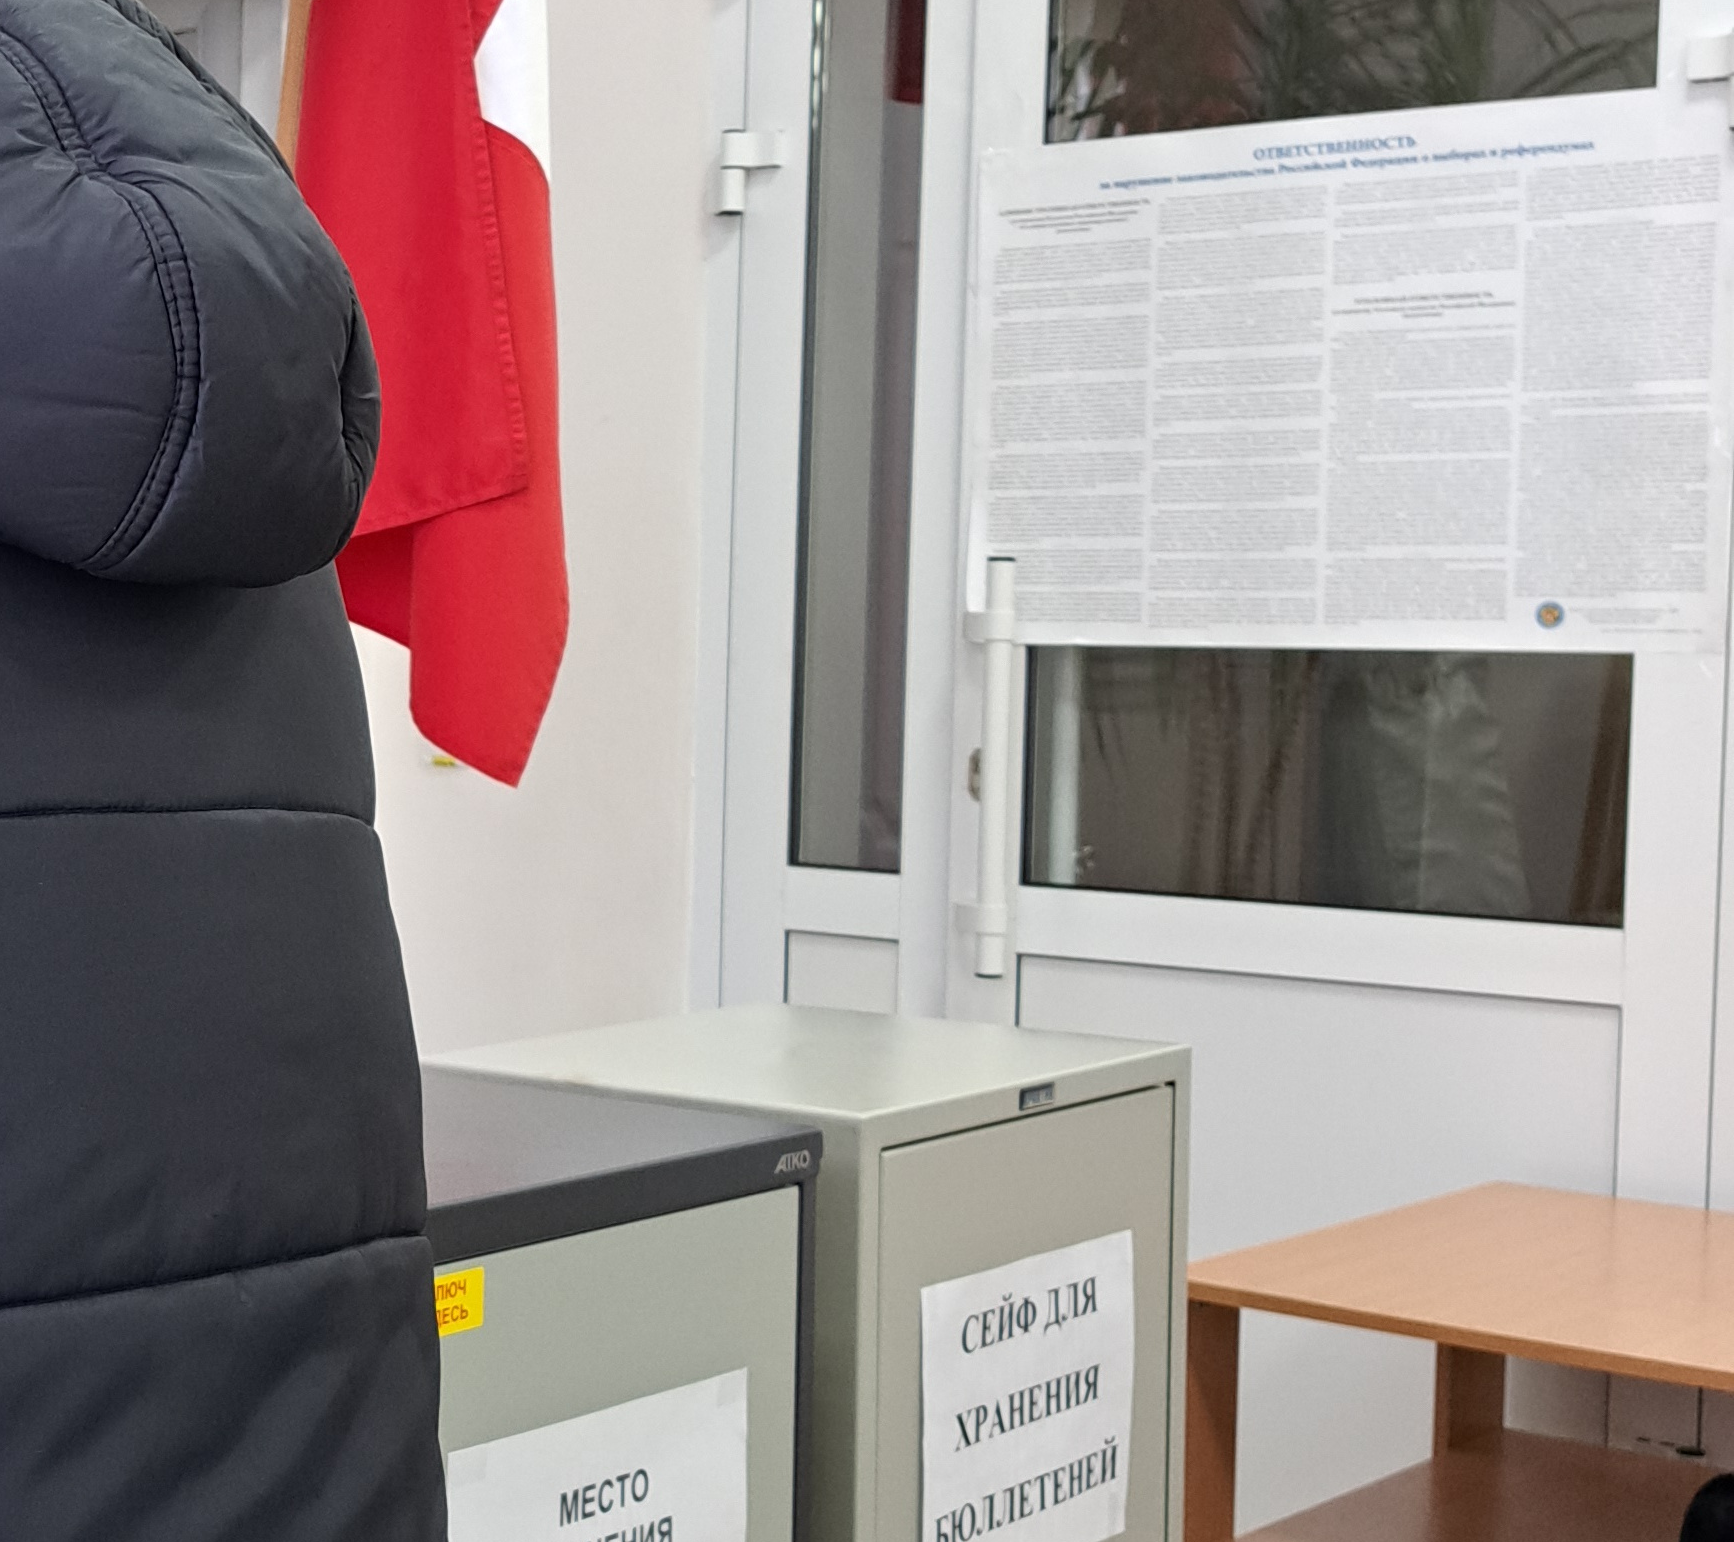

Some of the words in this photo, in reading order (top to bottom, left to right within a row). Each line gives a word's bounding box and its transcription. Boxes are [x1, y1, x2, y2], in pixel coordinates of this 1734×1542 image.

[1252, 135, 1416, 161] ОТВЕТСТВЕННОСТЬ
[435, 1278, 467, 1301] ЛЮЧ
[961, 1293, 1038, 1354] СЕЙФ
[1043, 1276, 1098, 1336] ДЛЯ
[954, 1363, 1101, 1452] ХРАНЕНИЯ
[559, 1468, 650, 1527] МЕСТО
